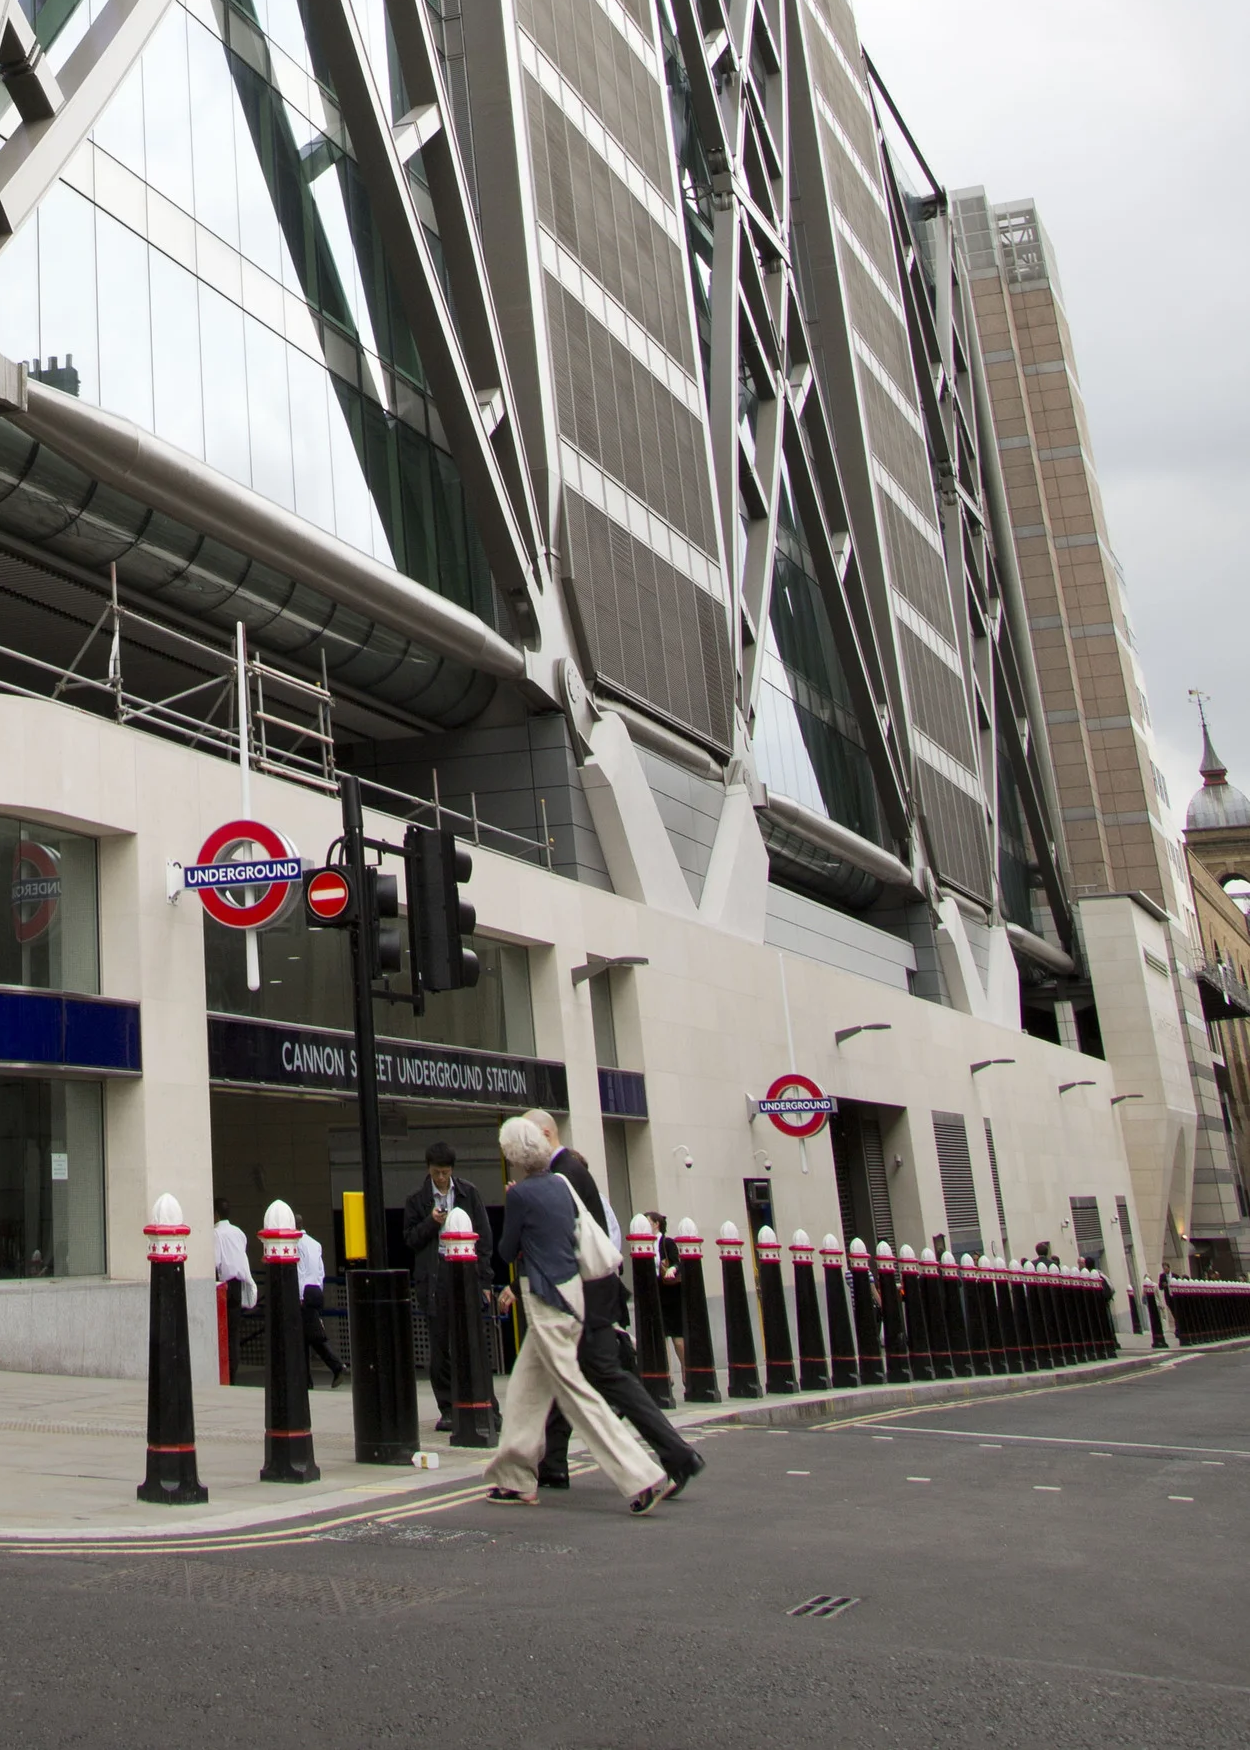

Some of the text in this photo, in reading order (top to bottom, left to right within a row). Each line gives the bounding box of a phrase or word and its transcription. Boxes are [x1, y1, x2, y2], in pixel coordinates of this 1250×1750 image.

[187, 862, 299, 884] UNDERGROUND
[282, 1041, 345, 1077] CANNON
[397, 1057, 483, 1091] UNDERGROUND
[487, 1066, 527, 1095] STATION
[760, 1100, 831, 1111] UNDERGROUND
